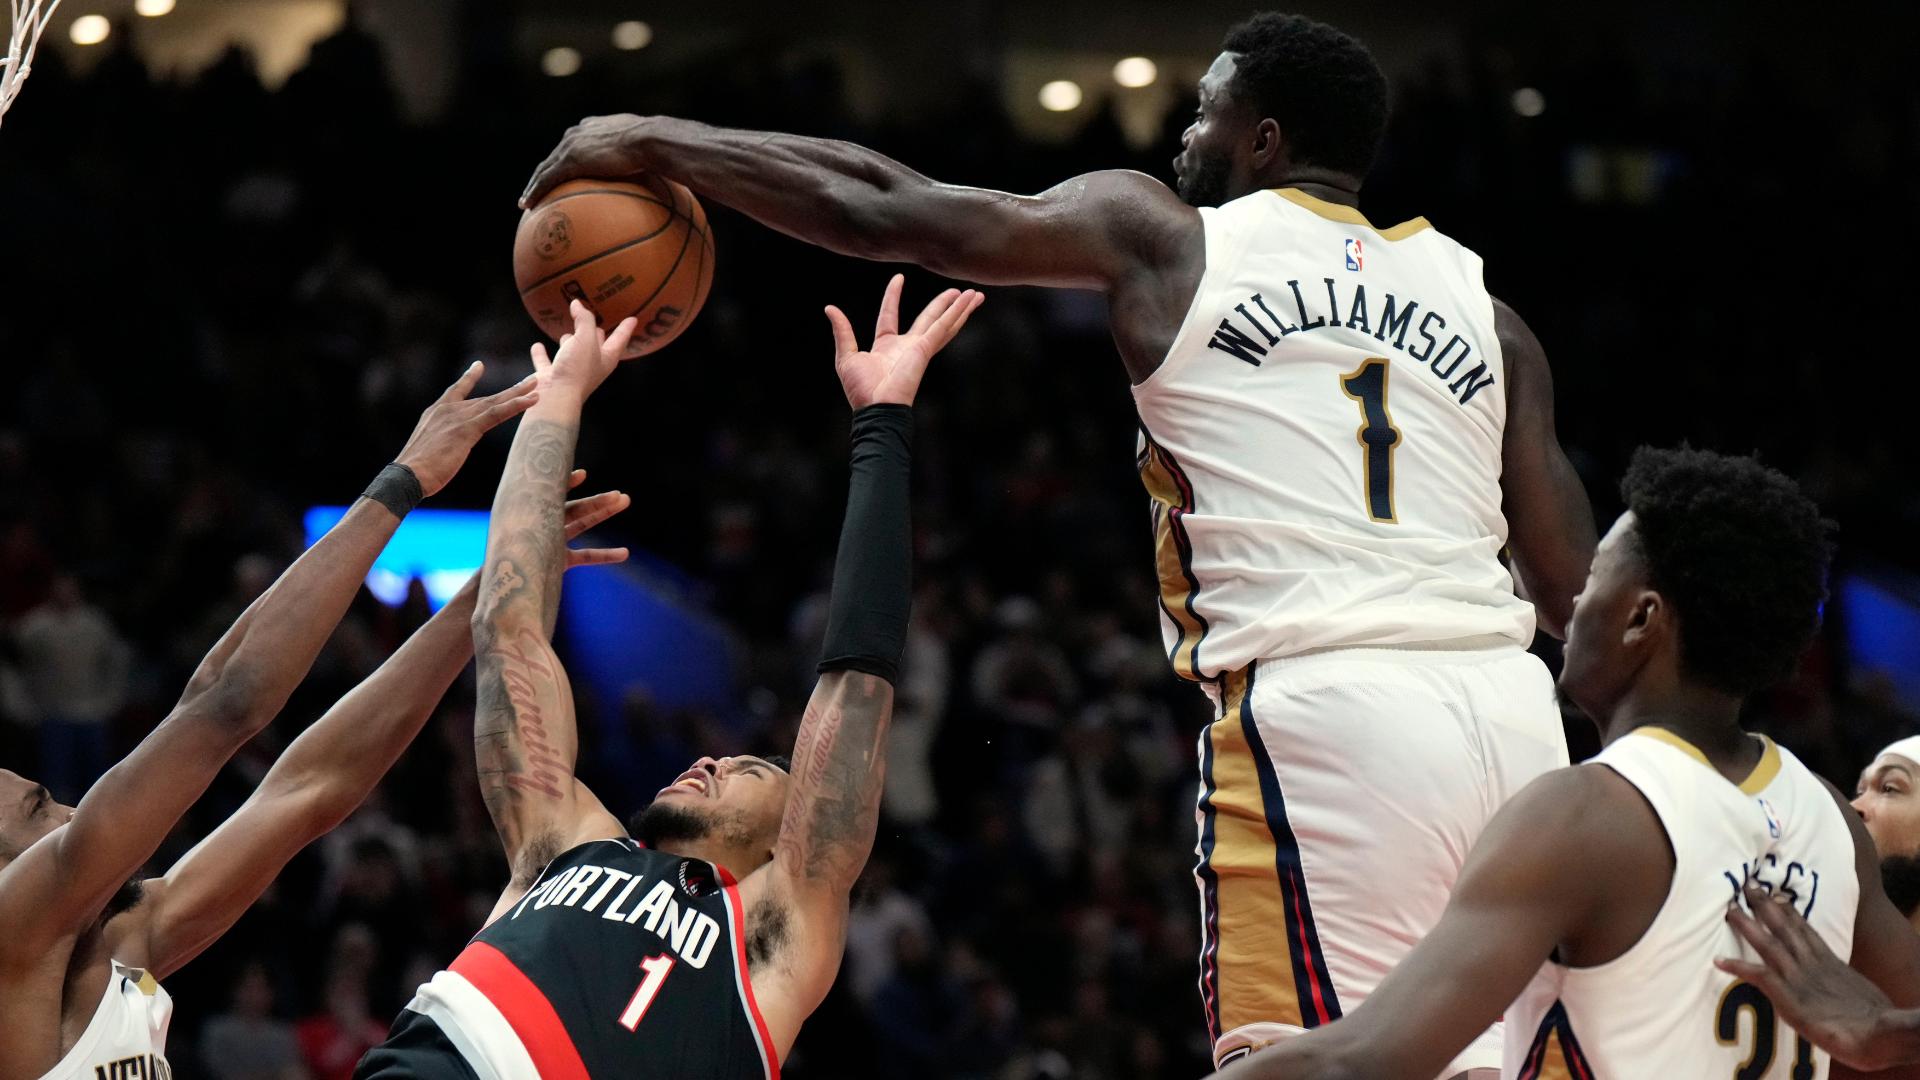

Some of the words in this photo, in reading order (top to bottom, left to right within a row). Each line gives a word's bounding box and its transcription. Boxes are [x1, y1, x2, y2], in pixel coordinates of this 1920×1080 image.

[1207, 277, 1495, 406] WILLIAMSON
[1339, 357, 1402, 525] 1
[489, 627, 573, 800] Family
[511, 864, 720, 970] PORTLAND
[617, 951, 677, 1033] 1
